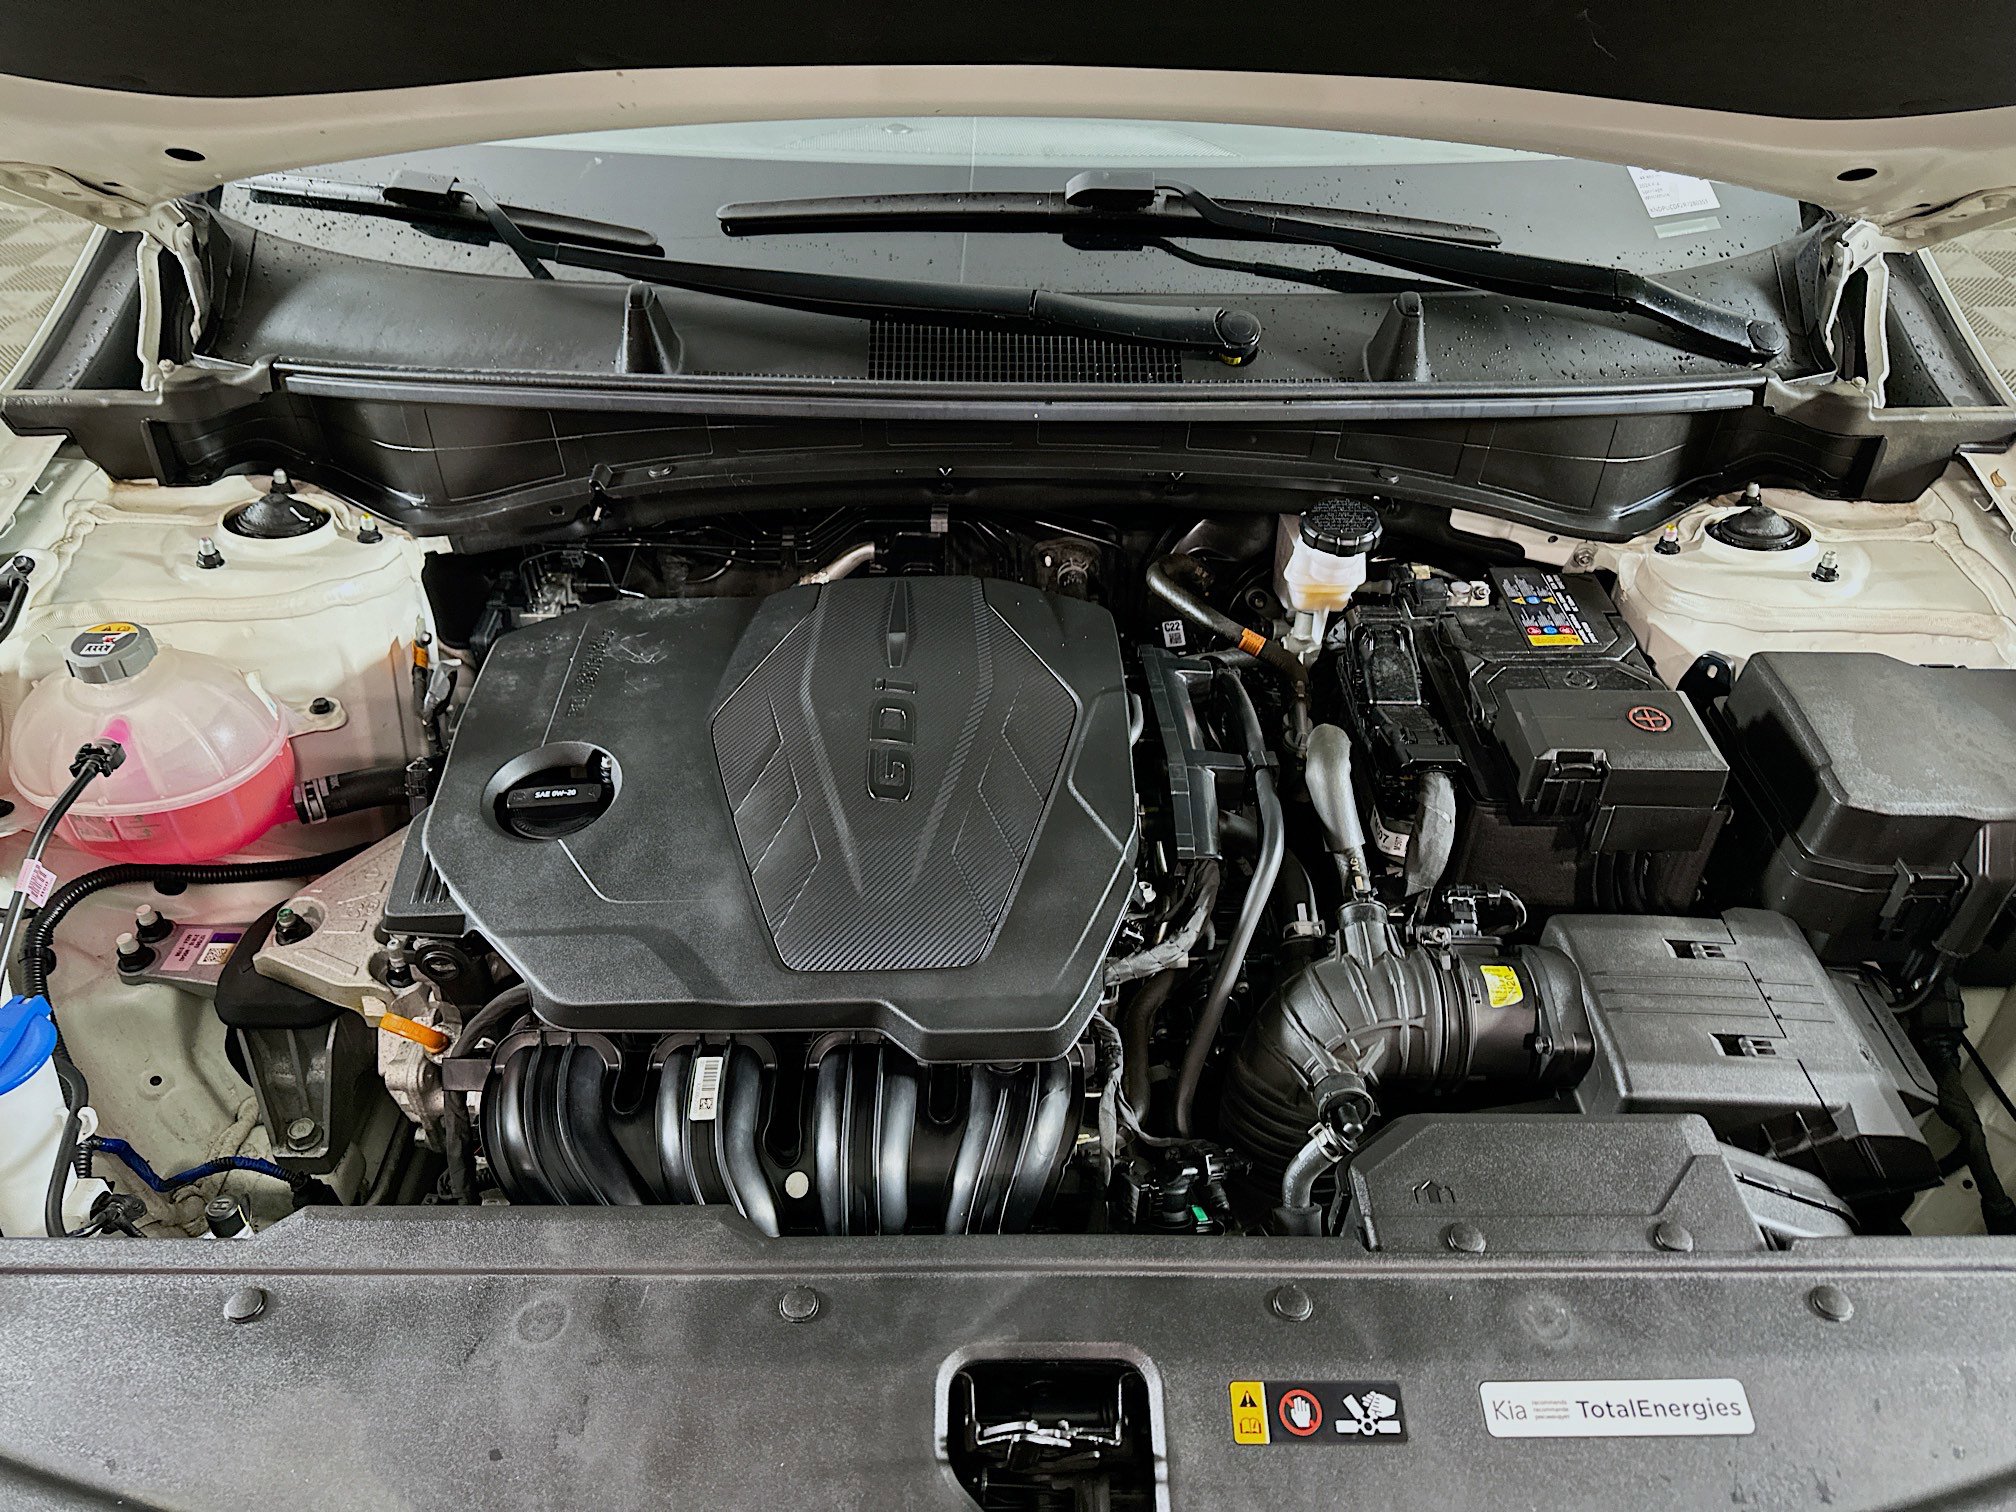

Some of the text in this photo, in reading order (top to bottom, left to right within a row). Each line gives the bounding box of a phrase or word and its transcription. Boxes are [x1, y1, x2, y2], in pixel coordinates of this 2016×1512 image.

[1164, 621, 1181, 632] C22
[534, 788, 577, 799] SAE 0W-20
[1492, 1399, 1528, 1421] Kia
[1575, 1397, 1742, 1421] TotalEnergies
